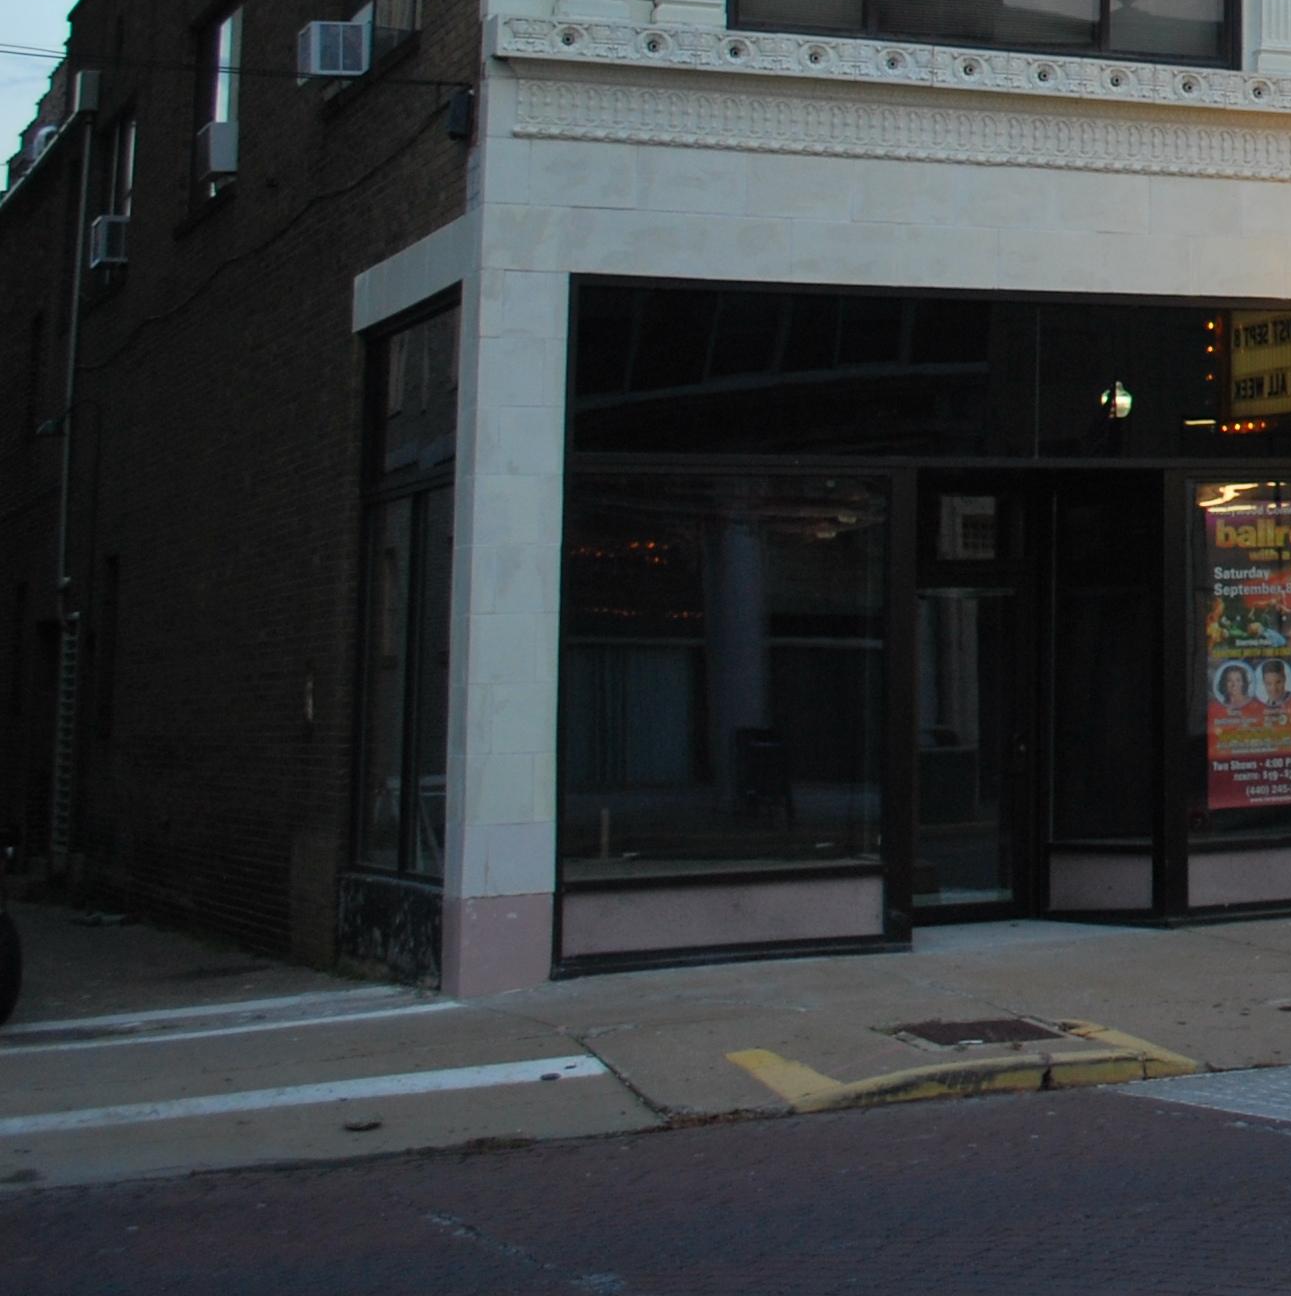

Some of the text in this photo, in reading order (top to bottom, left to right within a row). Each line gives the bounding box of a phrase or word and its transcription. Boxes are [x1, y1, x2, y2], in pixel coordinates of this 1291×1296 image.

[1213, 566, 1271, 581] Saturday
[1213, 583, 1281, 598] September
[1212, 761, 1229, 772] Two
